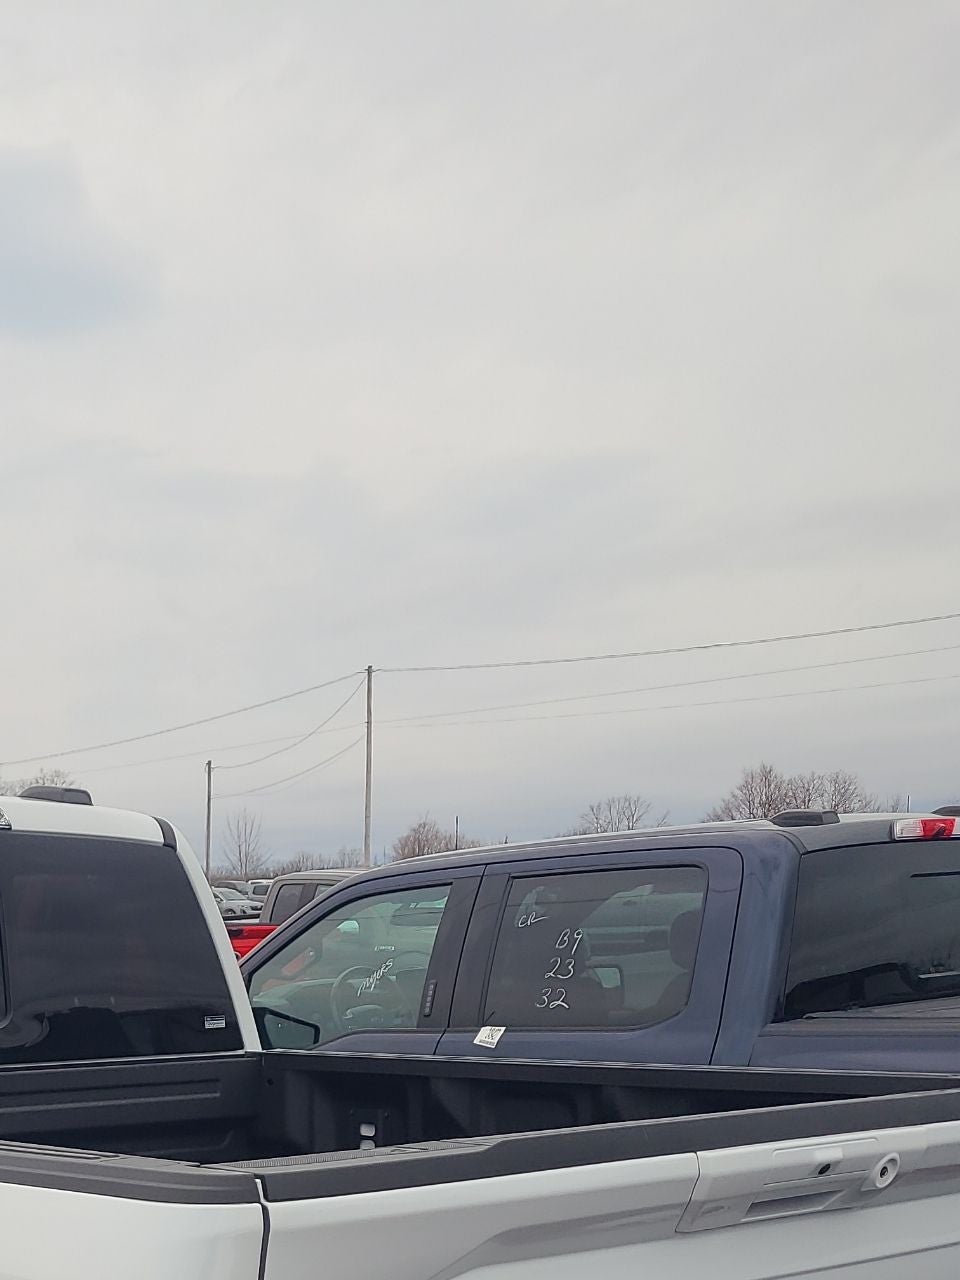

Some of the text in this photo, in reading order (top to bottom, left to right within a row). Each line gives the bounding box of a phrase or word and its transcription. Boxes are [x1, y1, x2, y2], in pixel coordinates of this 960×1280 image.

[555, 928, 583, 956] B9
[544, 957, 575, 979] 23
[534, 987, 570, 1009] 32
